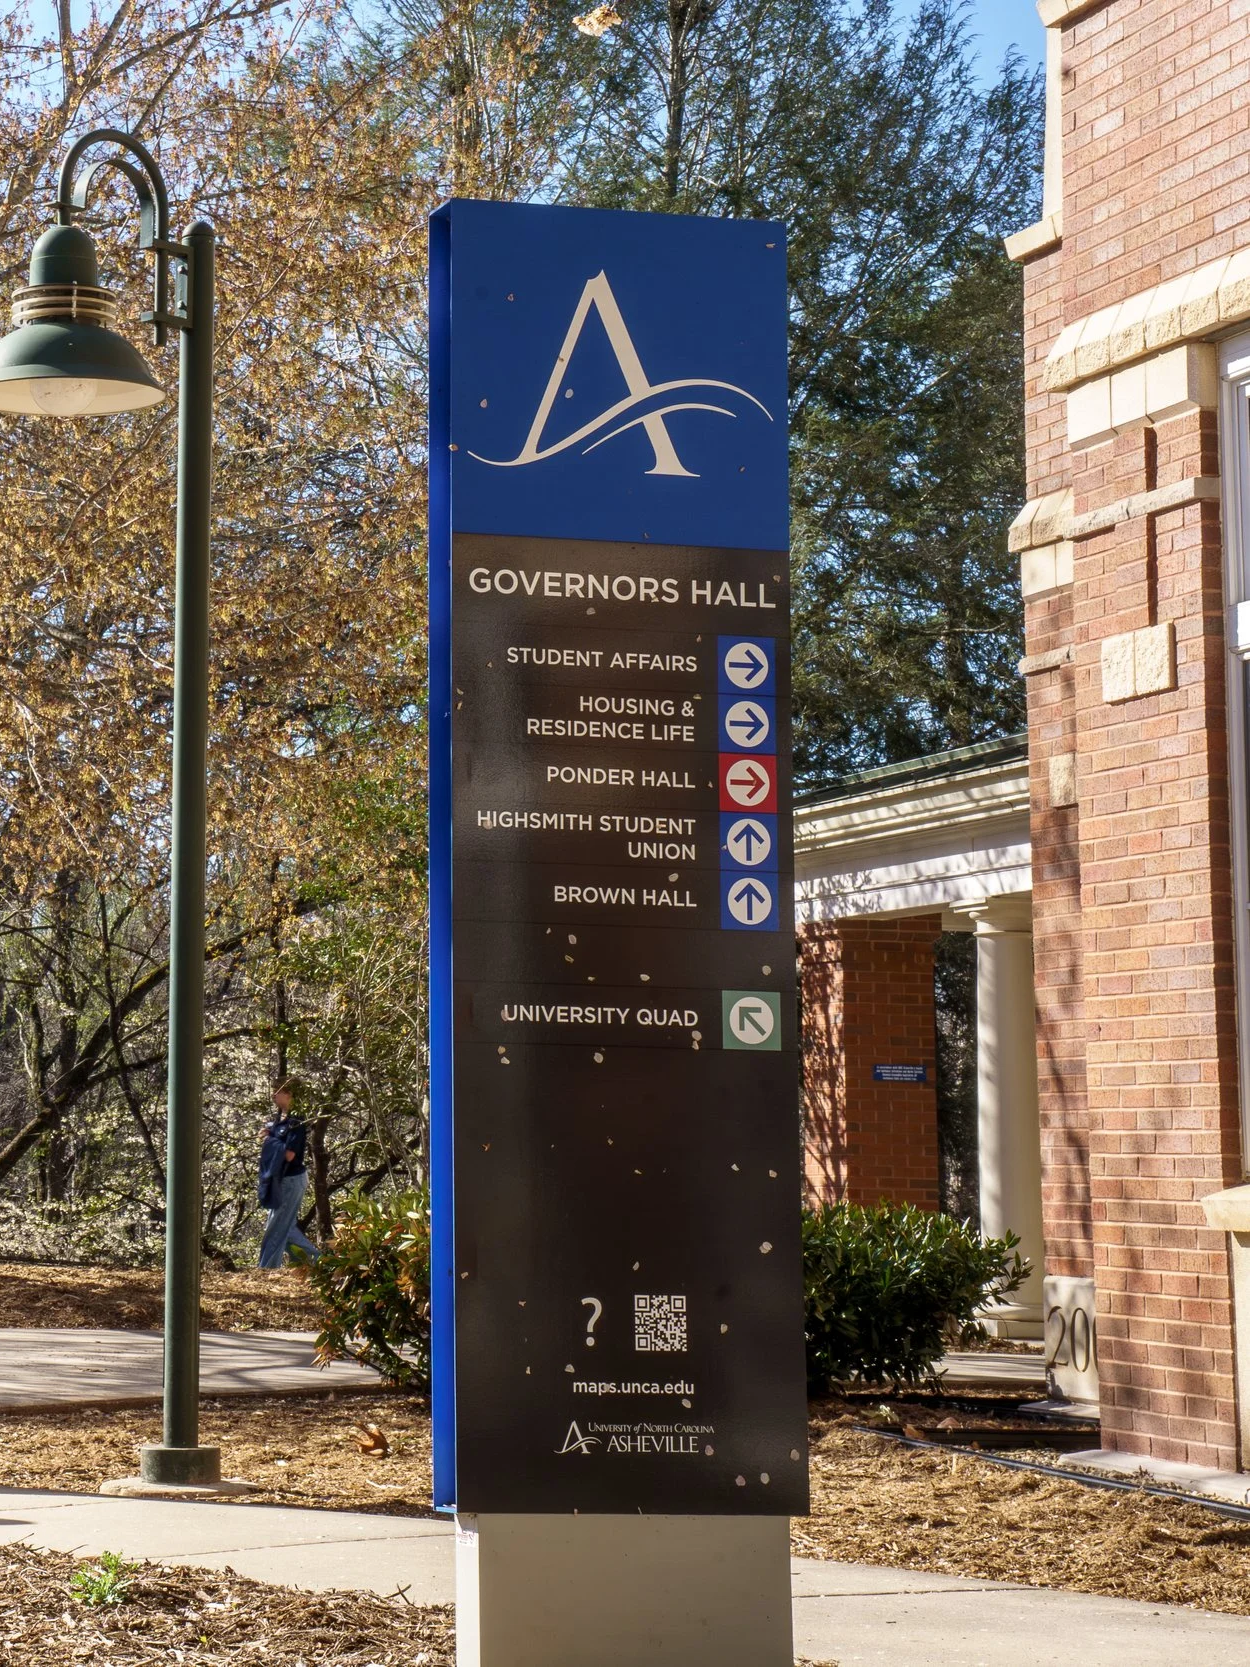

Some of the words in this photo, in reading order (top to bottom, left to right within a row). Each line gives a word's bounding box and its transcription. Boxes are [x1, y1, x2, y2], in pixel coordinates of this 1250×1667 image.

[468, 567, 679, 603] GOVERNORS
[691, 579, 776, 609] HALL
[507, 646, 603, 668] STUDENT
[609, 652, 697, 672] AFFAIRS
[579, 695, 675, 716] HOUSING
[681, 700, 695, 717] &
[527, 718, 645, 740] RESIDENCE
[651, 724, 695, 742] LIFE
[547, 765, 635, 786] PONDER
[641, 770, 696, 789] HALL
[477, 810, 592, 831] HIGHSMITH
[599, 815, 696, 835] STUDENT
[628, 841, 696, 861] UNION
[554, 885, 635, 905] BROWN
[642, 889, 697, 907] HALL
[504, 1004, 630, 1025] UNIVERSITY
[636, 1008, 698, 1028] QUAD
[1047, 1305, 1098, 1373] 20
[573, 1379, 694, 1396] maps.unca.edu
[633, 1422, 642, 1434] of
[643, 1423, 673, 1433] NORTH
[674, 1423, 715, 1434] CAROLINA
[607, 1435, 700, 1453] ASHEVILLE
